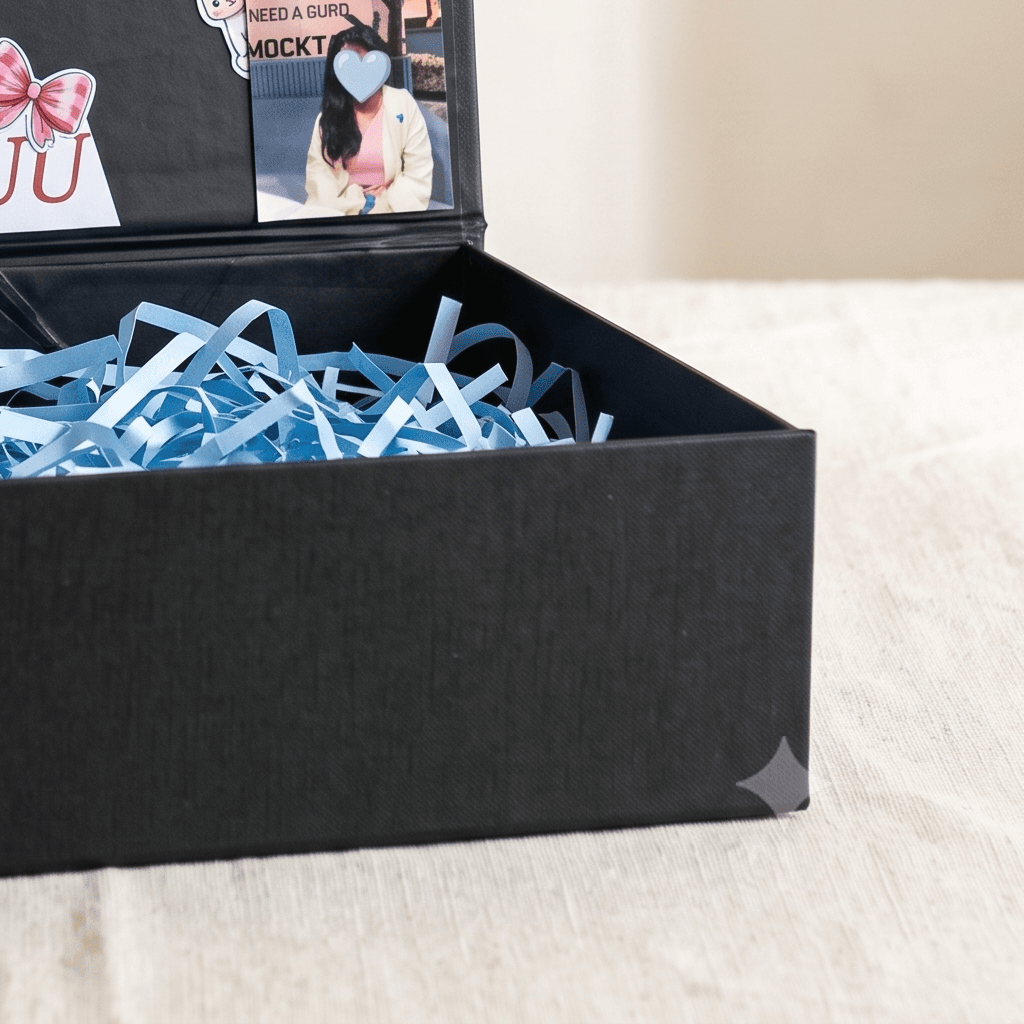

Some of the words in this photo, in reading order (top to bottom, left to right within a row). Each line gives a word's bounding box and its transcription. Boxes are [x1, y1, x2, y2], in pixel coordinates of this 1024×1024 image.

[249, 7, 289, 23] NEED
[291, 5, 303, 20] A
[307, 2, 350, 19] GURD
